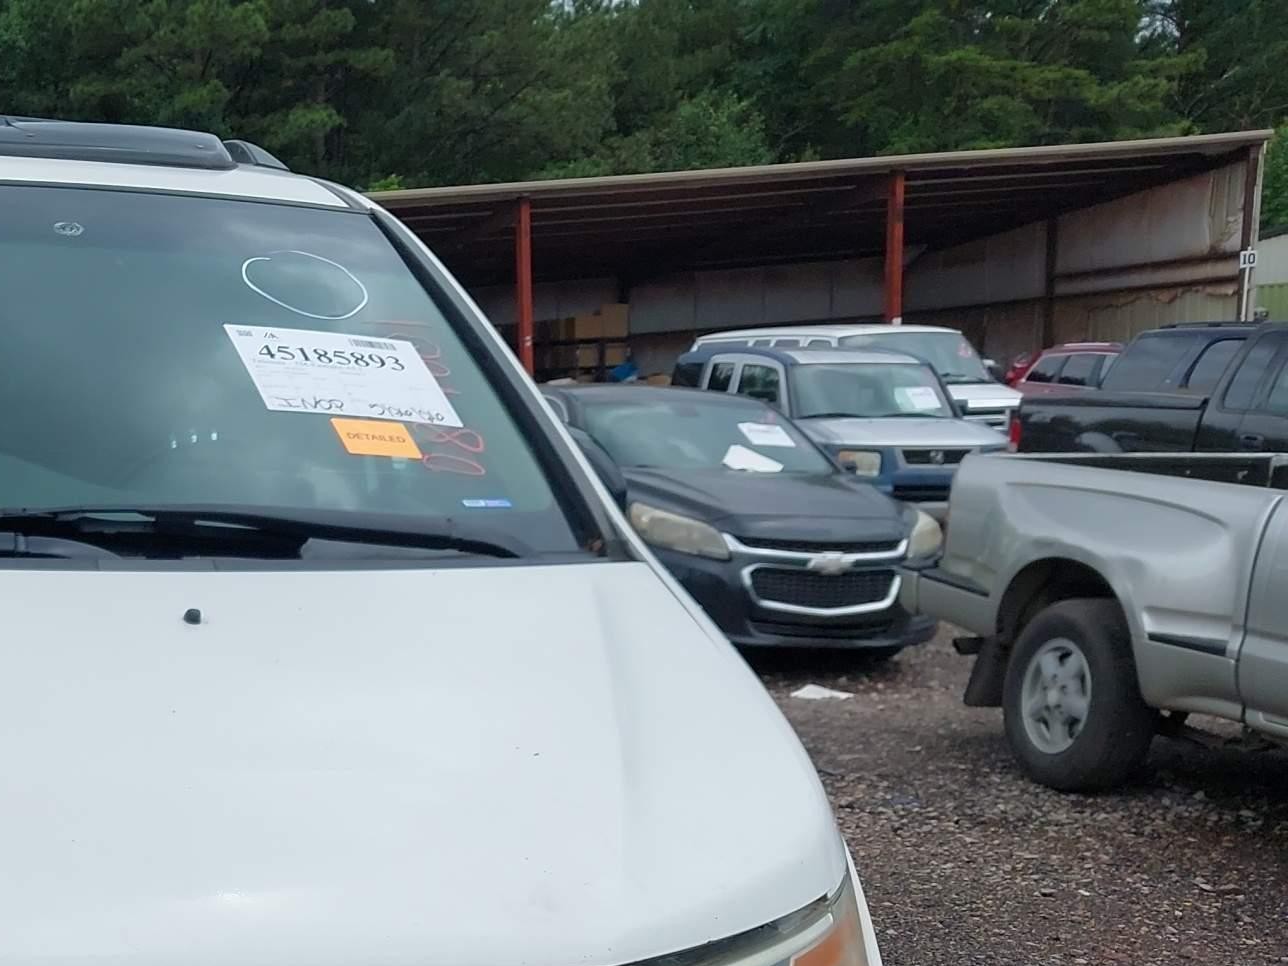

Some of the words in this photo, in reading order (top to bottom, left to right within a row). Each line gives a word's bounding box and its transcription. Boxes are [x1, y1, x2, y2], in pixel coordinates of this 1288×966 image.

[1243, 253, 1256, 265] 10
[258, 344, 405, 372] 45185893
[346, 432, 406, 444] DETAILED
